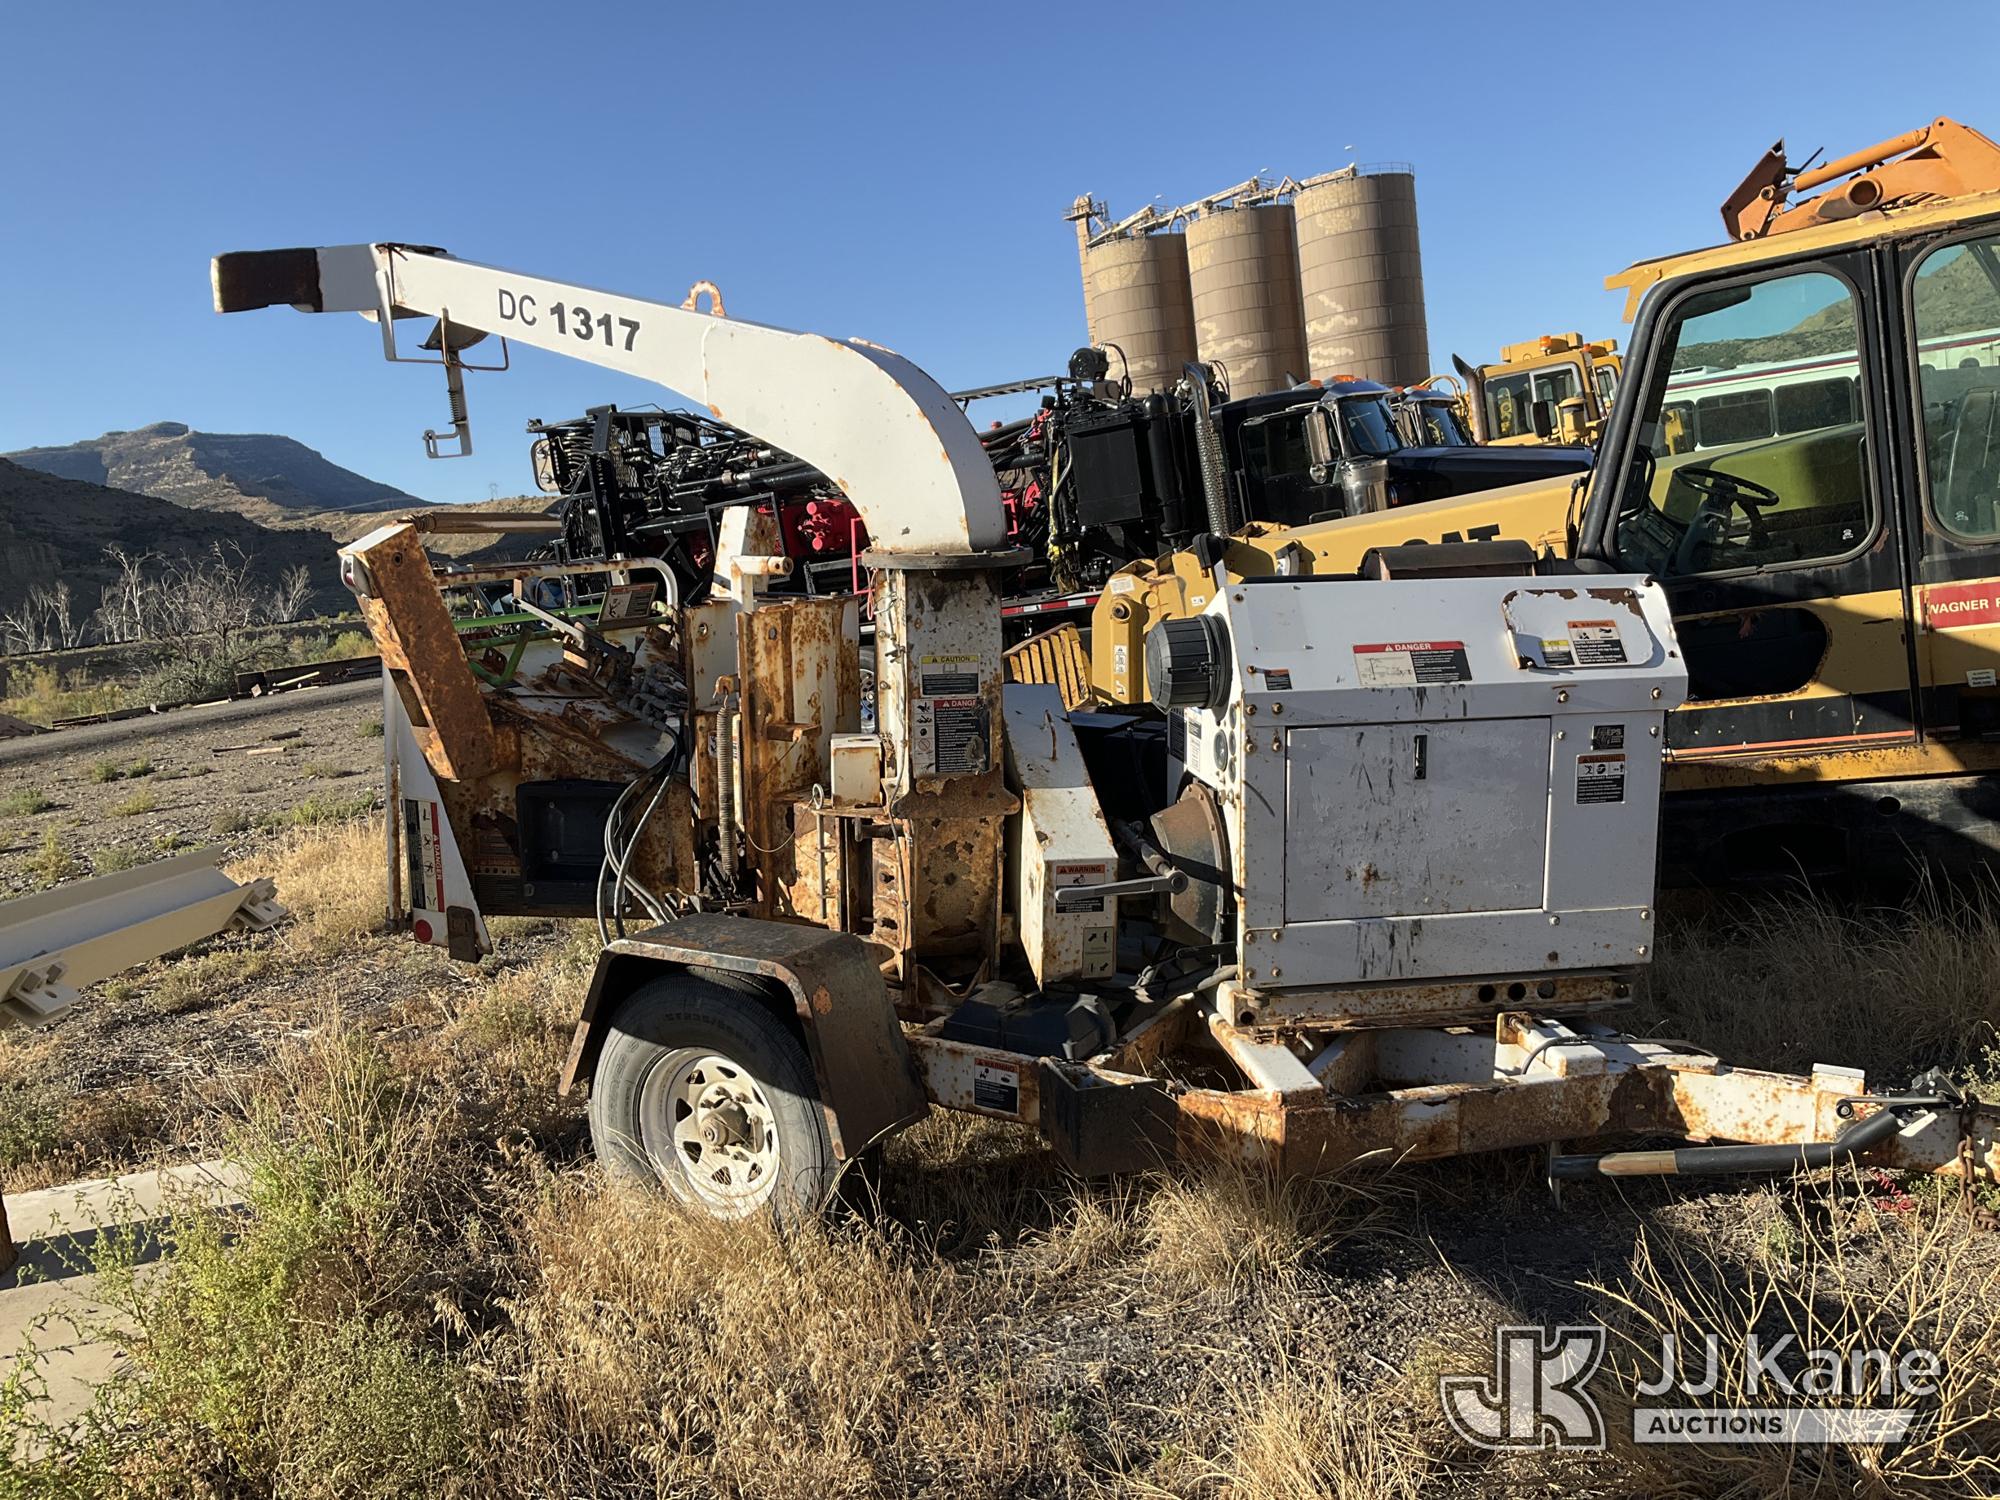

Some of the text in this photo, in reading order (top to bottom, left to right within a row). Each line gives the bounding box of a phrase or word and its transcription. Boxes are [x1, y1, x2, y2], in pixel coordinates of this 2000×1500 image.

[498, 288, 641, 352] DC 1317
[1395, 643, 1432, 651] DANGER
[434, 844, 443, 881] DANGER
[1068, 865, 1102, 873] WARNING
